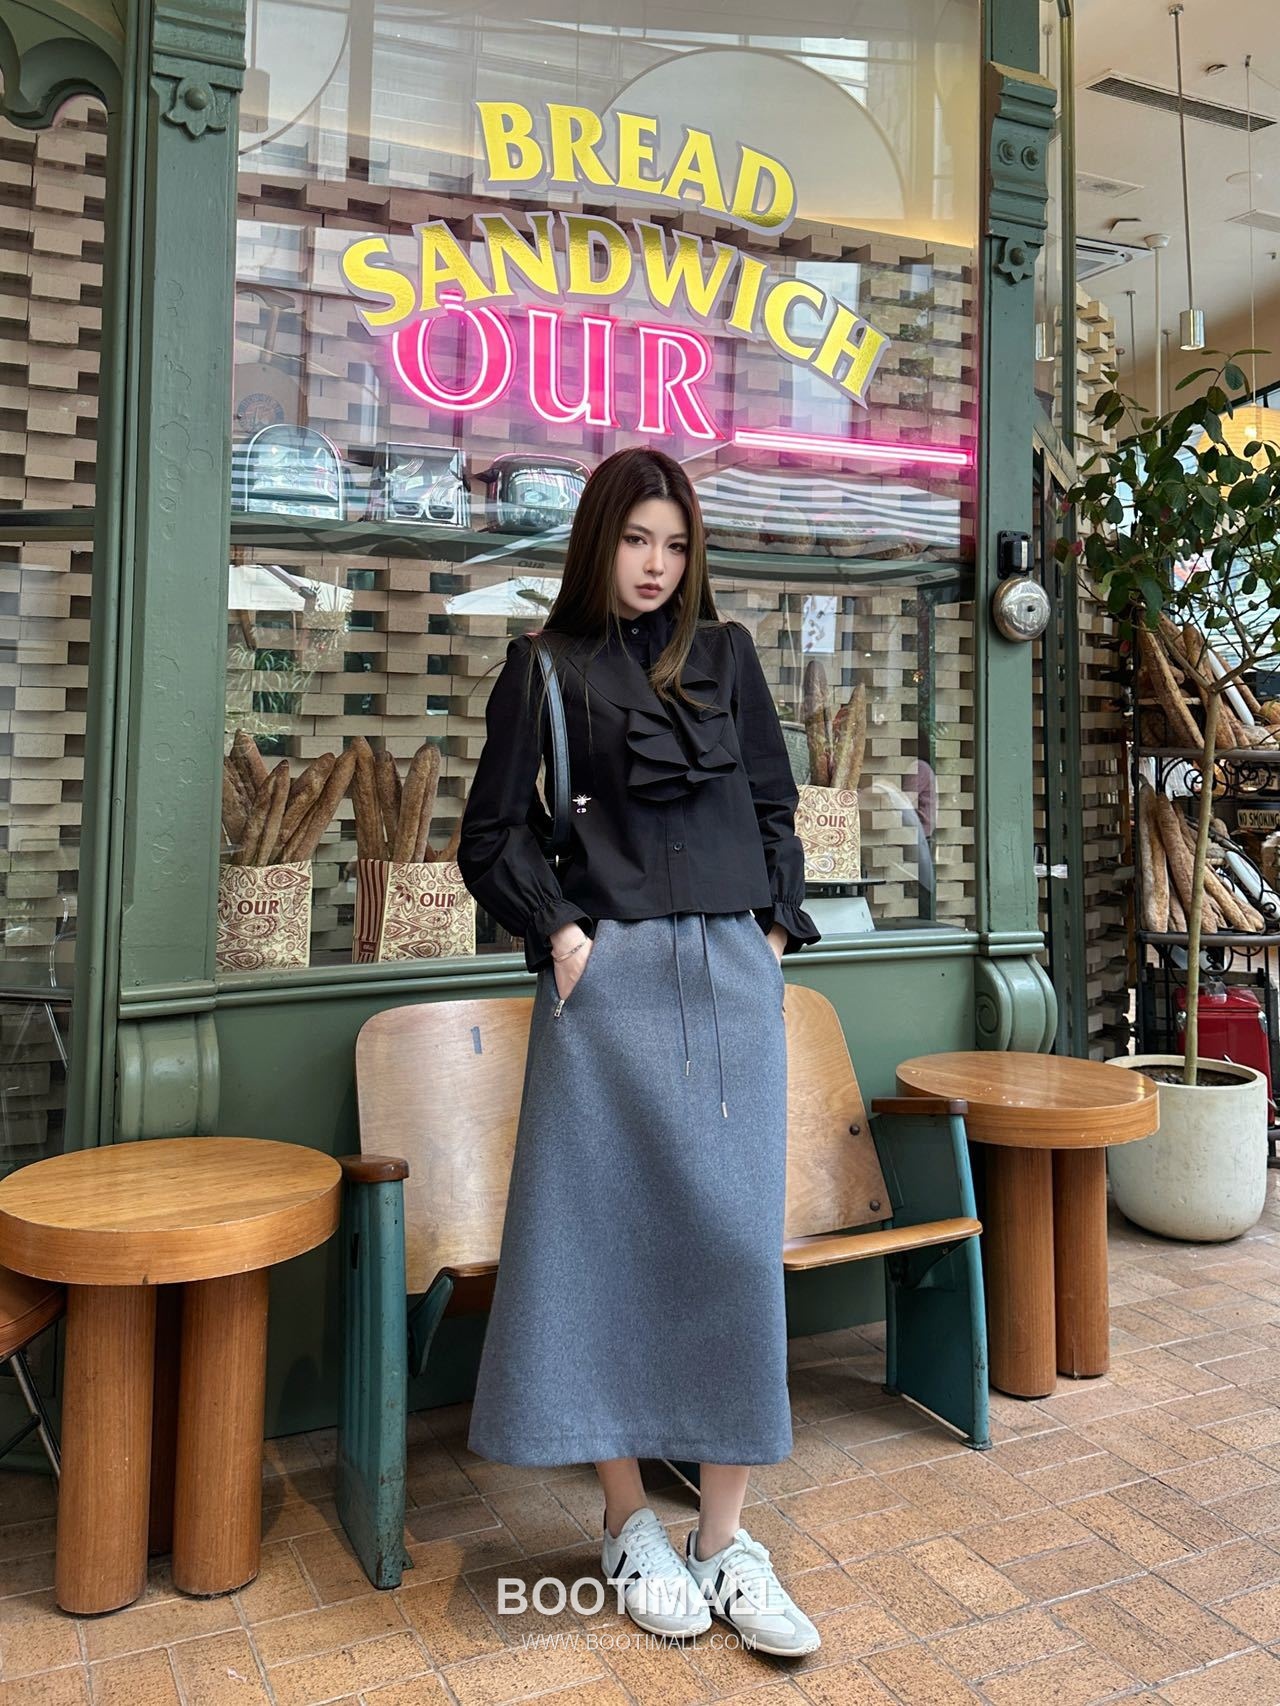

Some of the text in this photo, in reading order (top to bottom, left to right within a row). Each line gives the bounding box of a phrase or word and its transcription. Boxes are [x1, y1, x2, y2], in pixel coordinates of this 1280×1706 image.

[475, 101, 795, 229] BREAD
[342, 214, 887, 397] SANDWICH
[391, 289, 725, 440] OUR
[816, 814, 847, 828] OUR
[237, 899, 280, 915] OUR
[420, 892, 456, 908] OUR
